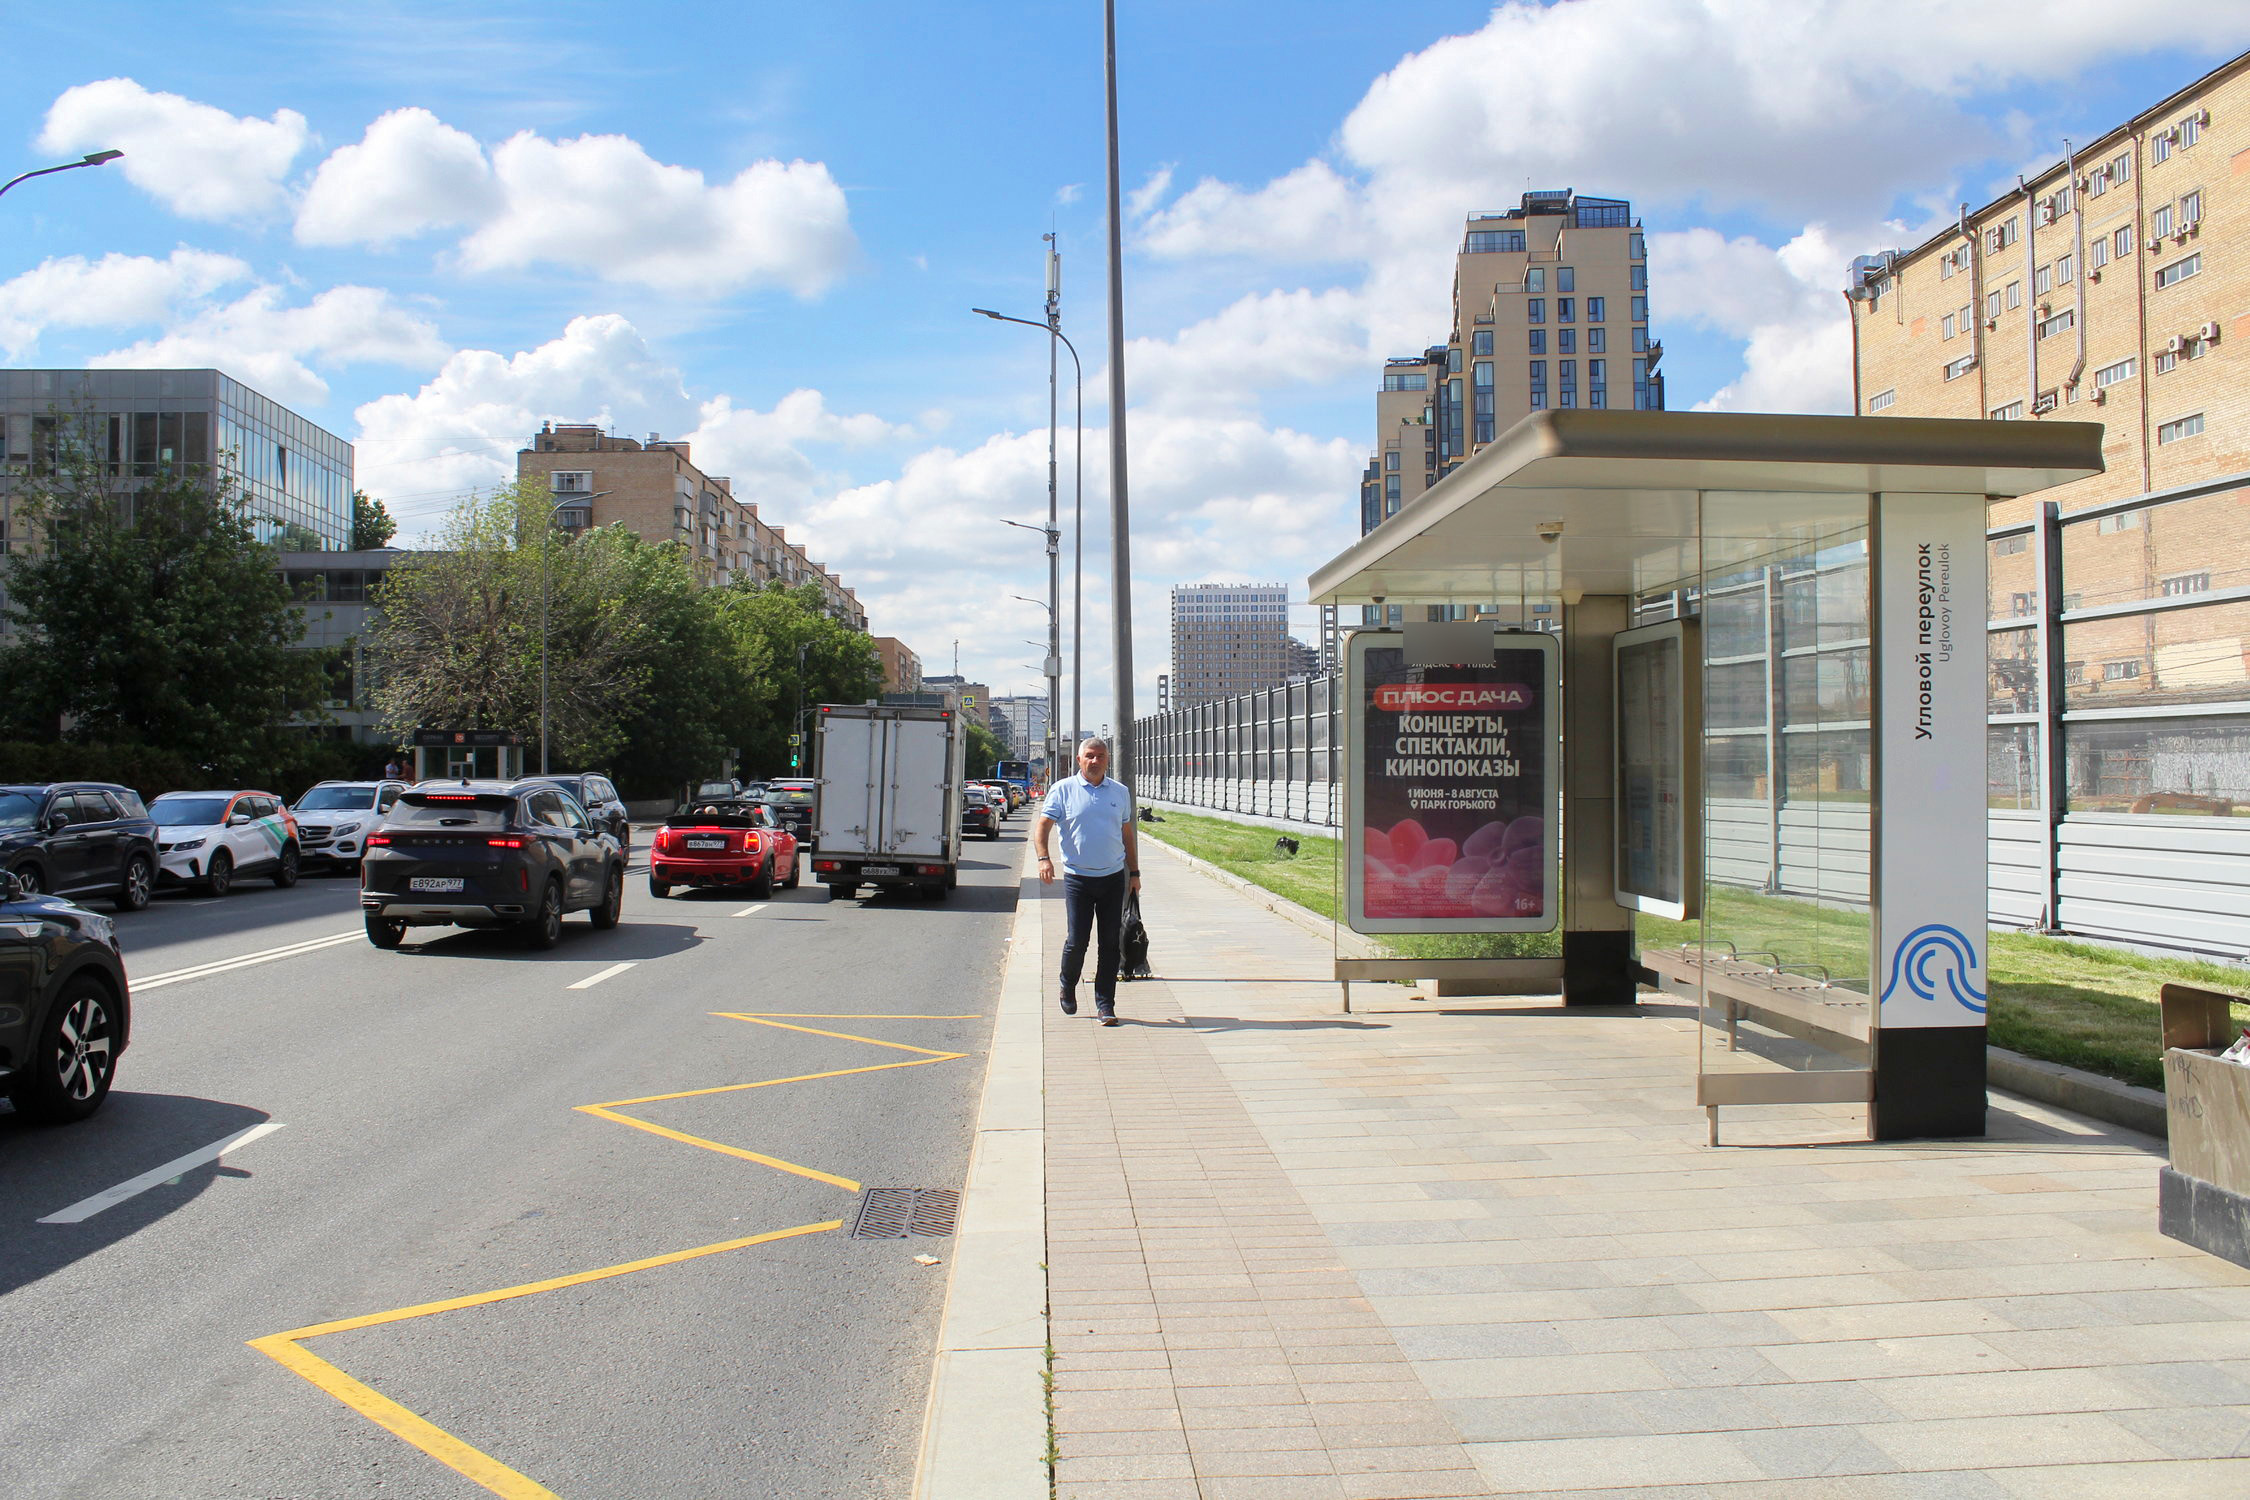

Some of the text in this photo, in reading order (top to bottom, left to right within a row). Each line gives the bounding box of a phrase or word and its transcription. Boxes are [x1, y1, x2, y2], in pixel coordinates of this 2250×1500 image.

[1937, 543, 1953, 662] Uglovoy Pereulok
[1915, 543, 1935, 740] Угловой переулок
[1383, 690, 1523, 706] ПЛЮС ДАЧА
[1399, 715, 1508, 736] КОНЦЕРТЫ,
[1395, 737, 1511, 758] СПЕКТАКЛИ,
[1385, 759, 1520, 777] КИНОПОКАЗЫ
[1413, 788, 1444, 798] ИЮНЯ
[1452, 788, 1457, 798] 8
[1459, 788, 1499, 798] АВГУСТА
[1420, 799, 1496, 809] ПАРК ГОРЬКОГО
[1514, 899, 1535, 910] 16+
